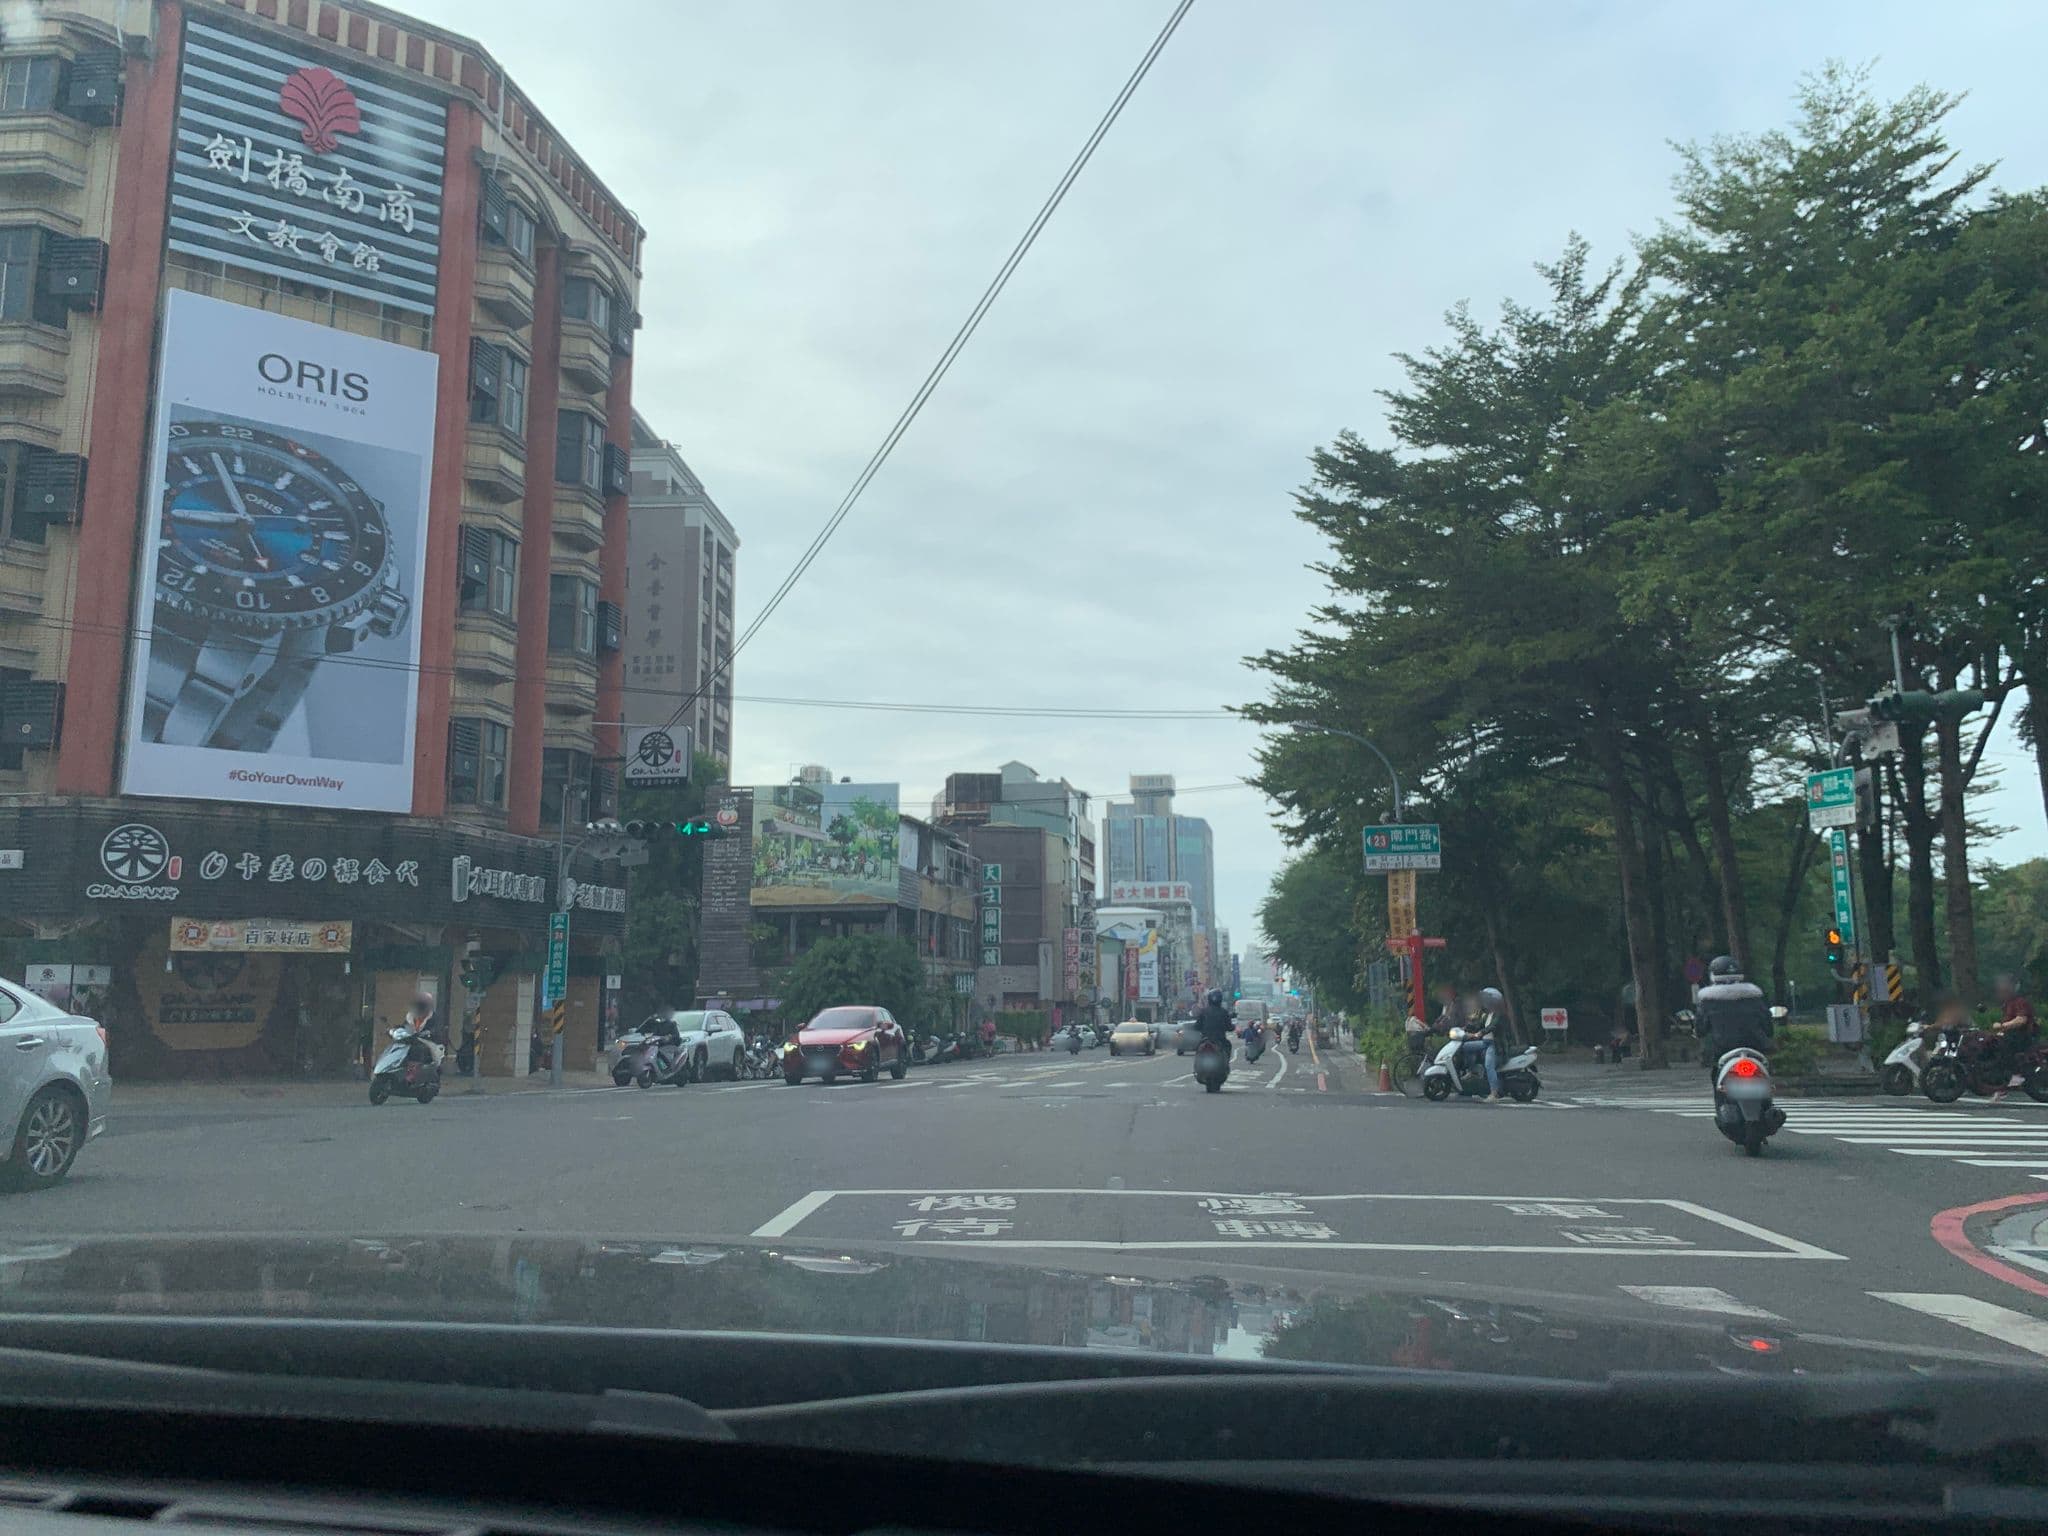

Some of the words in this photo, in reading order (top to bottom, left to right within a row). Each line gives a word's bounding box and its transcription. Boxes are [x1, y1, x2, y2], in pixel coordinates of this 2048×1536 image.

[228, 210, 383, 271] 文教會館
[258, 353, 369, 402] ORIS
[220, 425, 254, 441] 22
[245, 493, 284, 514] ORIS
[228, 769, 344, 792] #GoYourOwnWay
[1373, 834, 1386, 847] 23
[1390, 829, 1432, 842] 南門路
